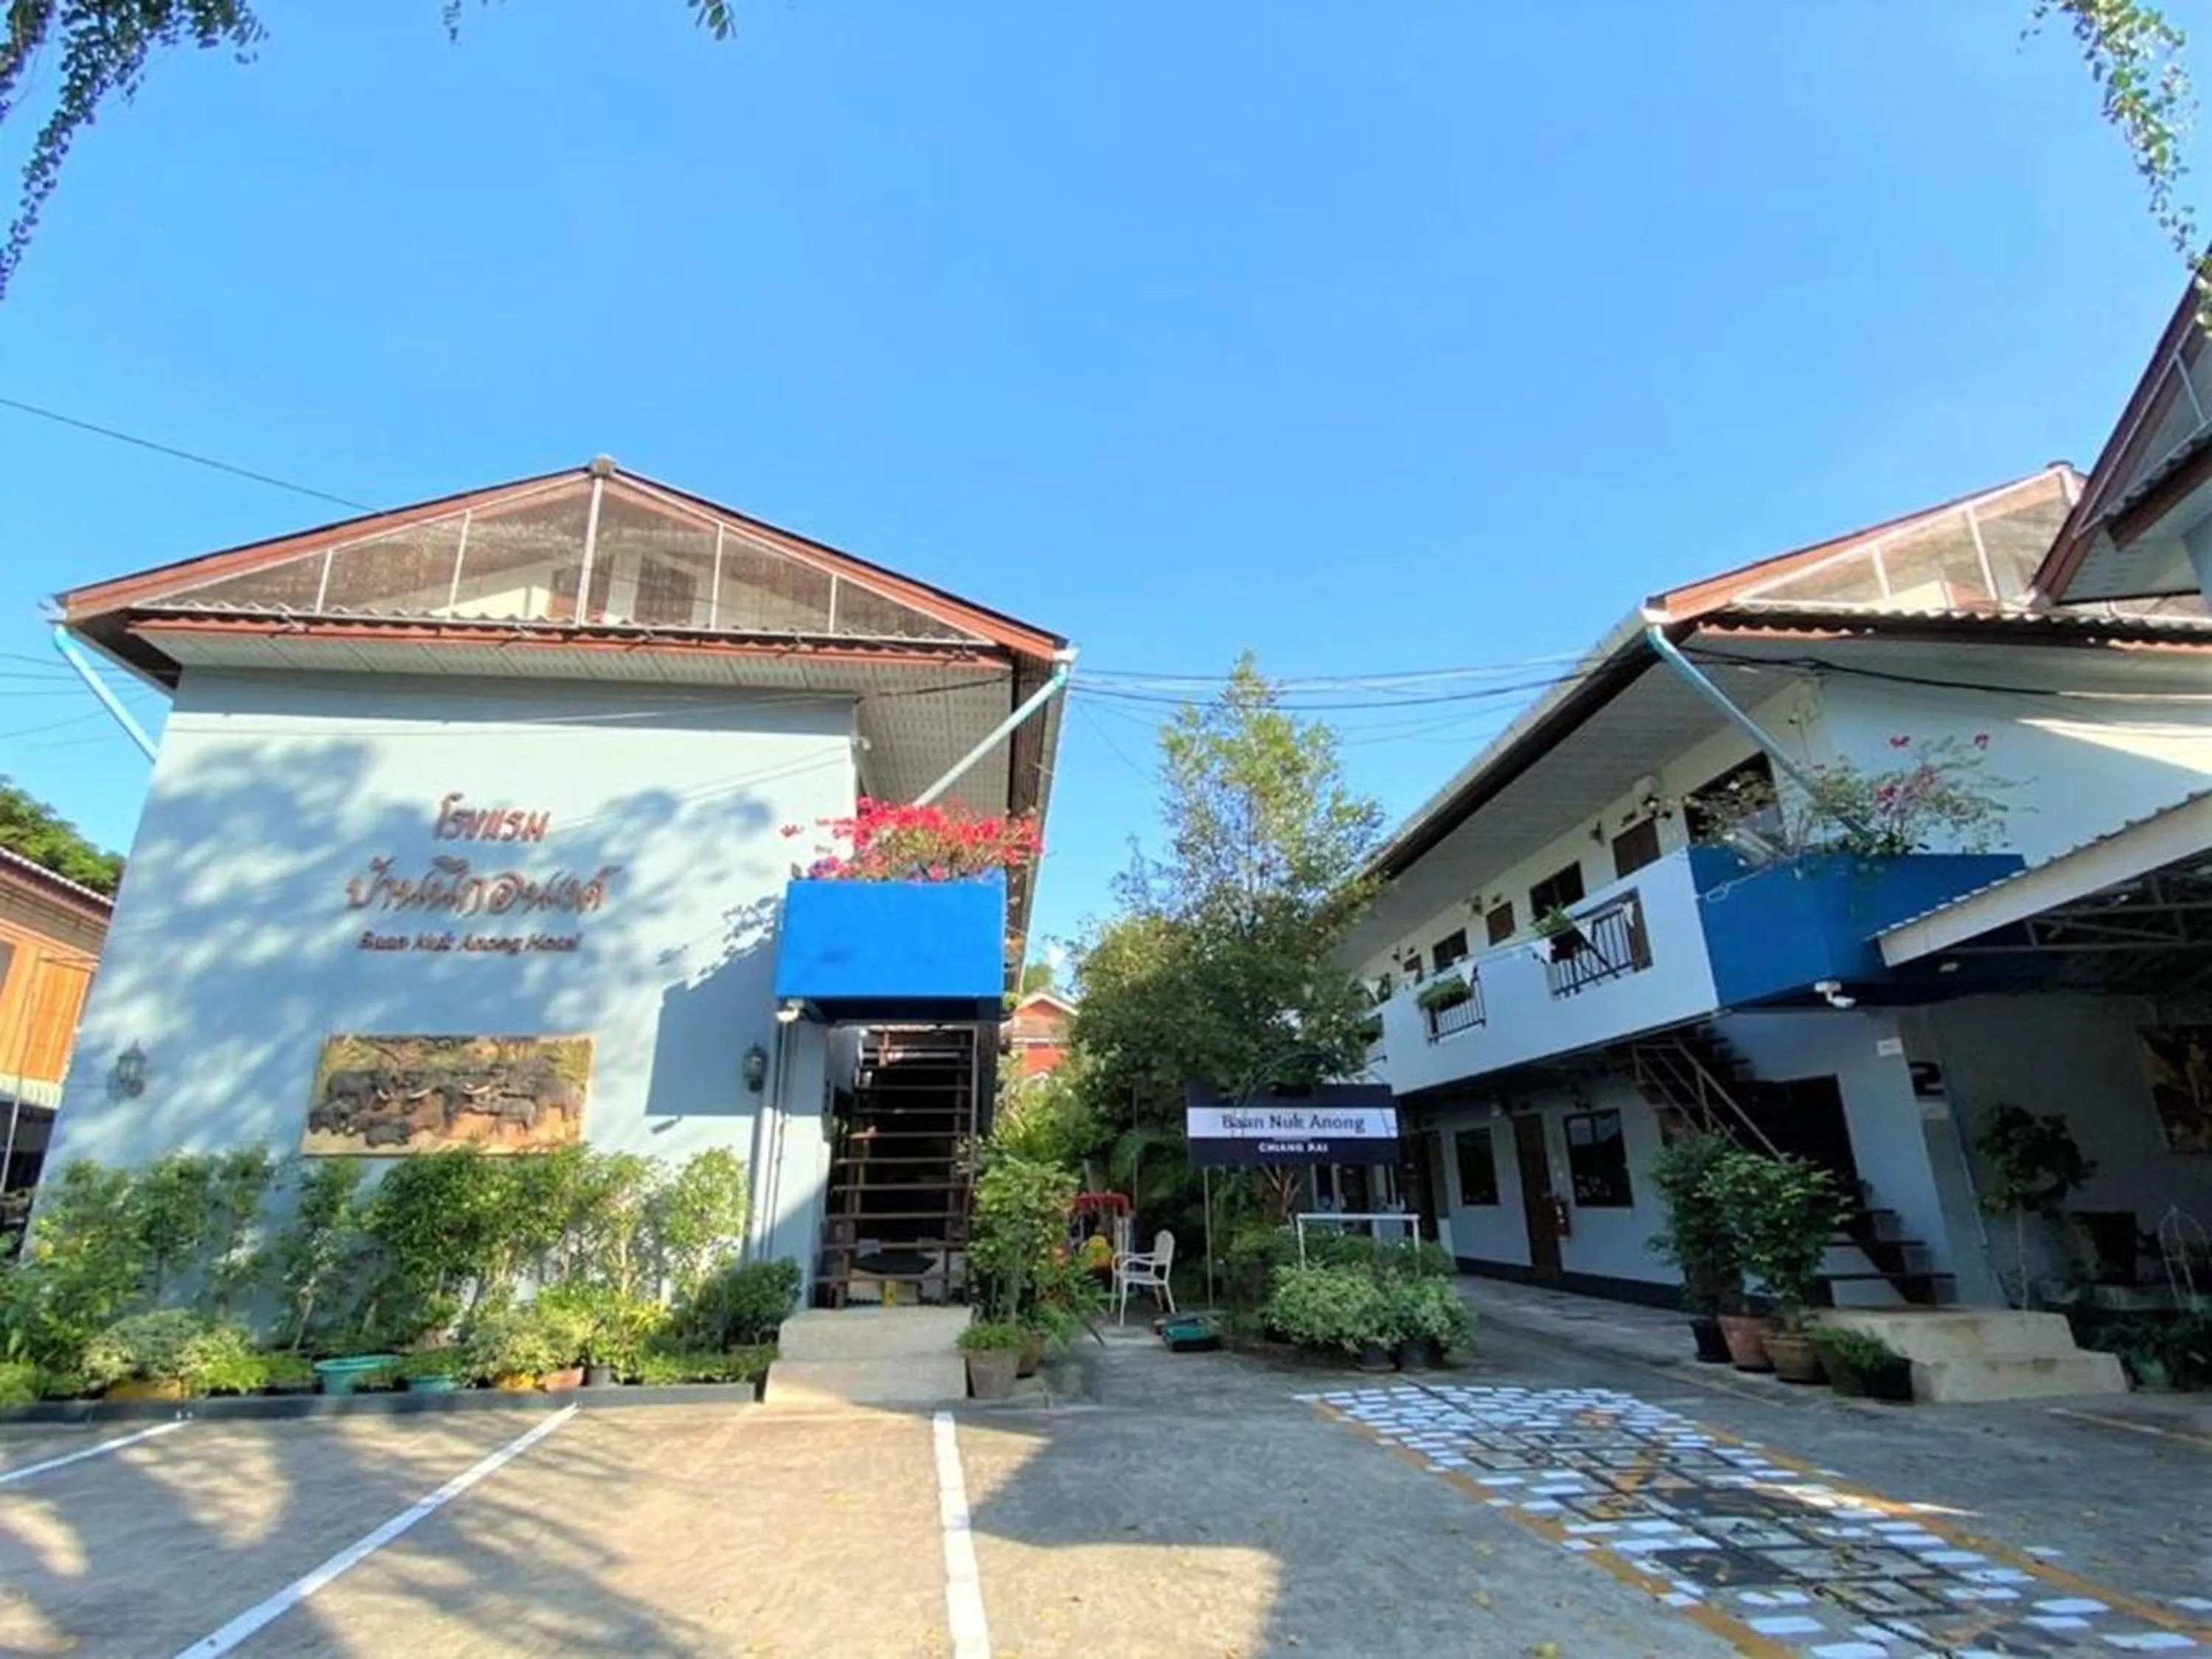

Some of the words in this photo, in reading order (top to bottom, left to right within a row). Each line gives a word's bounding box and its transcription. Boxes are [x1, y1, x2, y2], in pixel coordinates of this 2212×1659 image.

[435, 792, 551, 842] โรงแรม
[1269, 1113, 1304, 1129] Nuk
[1310, 1114, 1366, 1134] Anong
[1258, 1144, 1304, 1152] CHIANG
[1307, 1144, 1328, 1152] RAI
